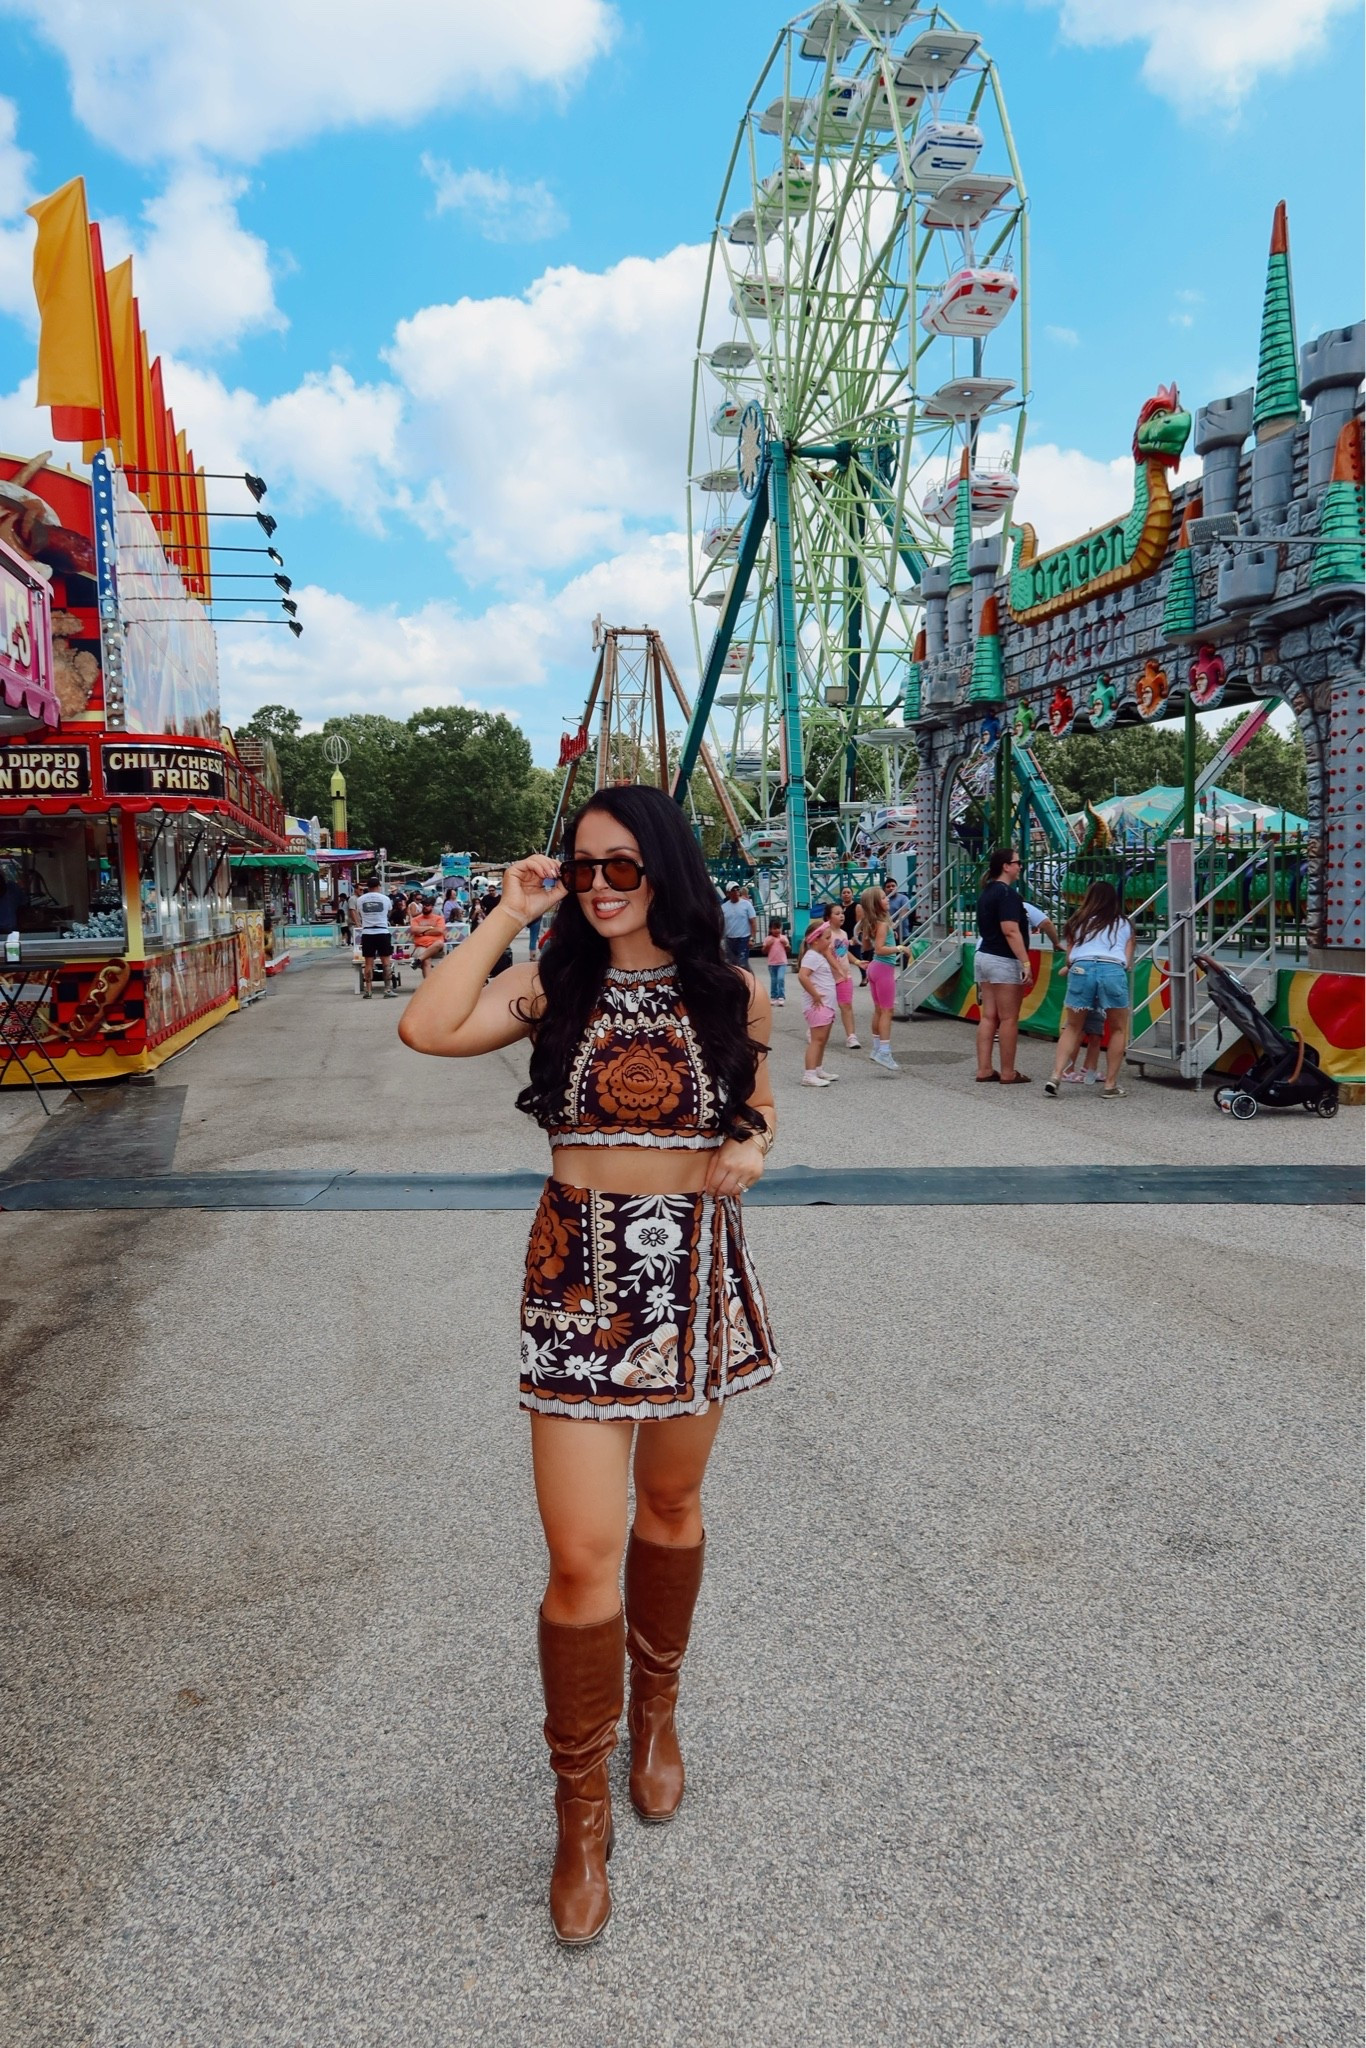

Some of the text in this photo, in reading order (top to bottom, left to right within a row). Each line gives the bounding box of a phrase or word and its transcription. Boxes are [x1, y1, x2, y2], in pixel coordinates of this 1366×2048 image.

[1031, 524, 1127, 605] Dragon
[8, 753, 80, 769] DIPPED
[19, 768, 79, 789] DOGS
[152, 770, 209, 790] FRIES
[1198, 858, 1223, 869] ENER
